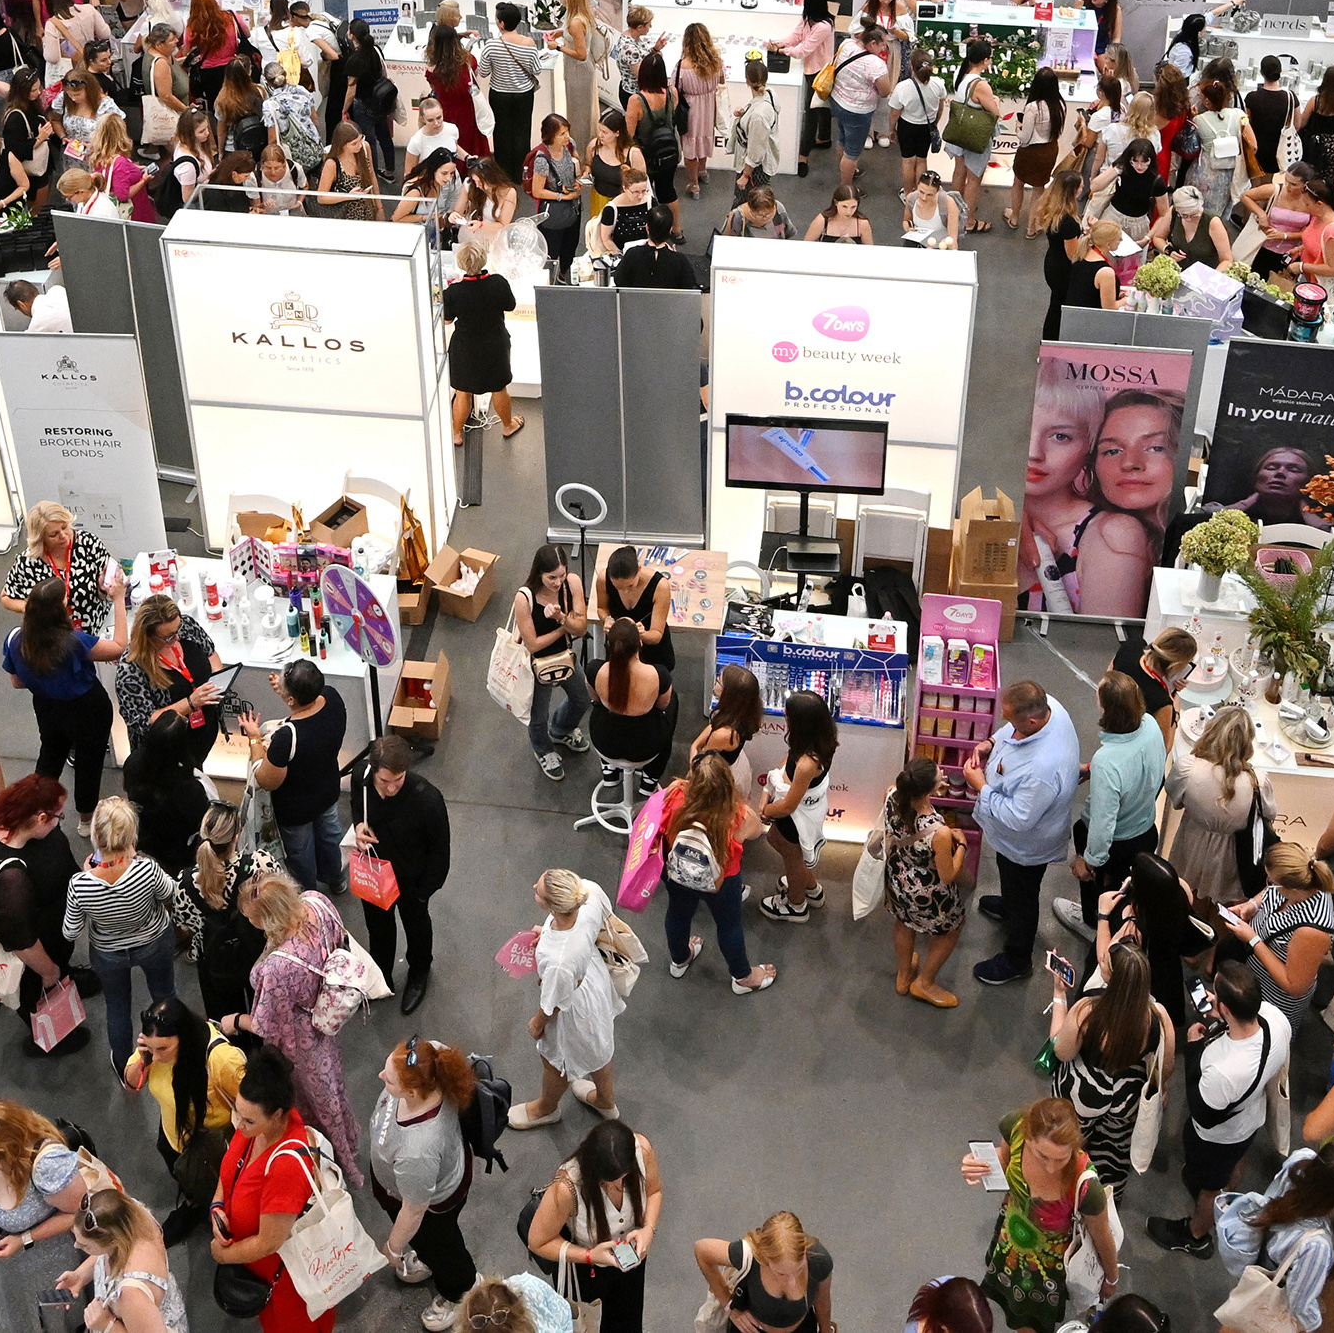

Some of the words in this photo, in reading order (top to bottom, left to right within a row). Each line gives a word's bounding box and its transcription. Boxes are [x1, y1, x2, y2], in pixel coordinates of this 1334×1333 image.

[1264, 19, 1308, 34] nerds.
[232, 332, 365, 353] KALLOS
[258, 353, 341, 366] COSMETICS
[773, 346, 799, 360] my
[803, 346, 857, 365] beauty
[860, 350, 901, 365] week
[1064, 363, 1160, 386] MOSSA
[784, 380, 897, 407] b.colour
[784, 401, 891, 415] PROFESSIONAL
[1227, 401, 1247, 418] In
[1250, 407, 1298, 424] your
[44, 427, 114, 438] RESTORING
[39, 439, 91, 448] BROKEN
[93, 440, 123, 450] HAIR
[61, 449, 105, 459] BONDS
[783, 644, 840, 659] b.colour
[829, 785, 849, 794] eek
[509, 953, 534, 968] TAPE
